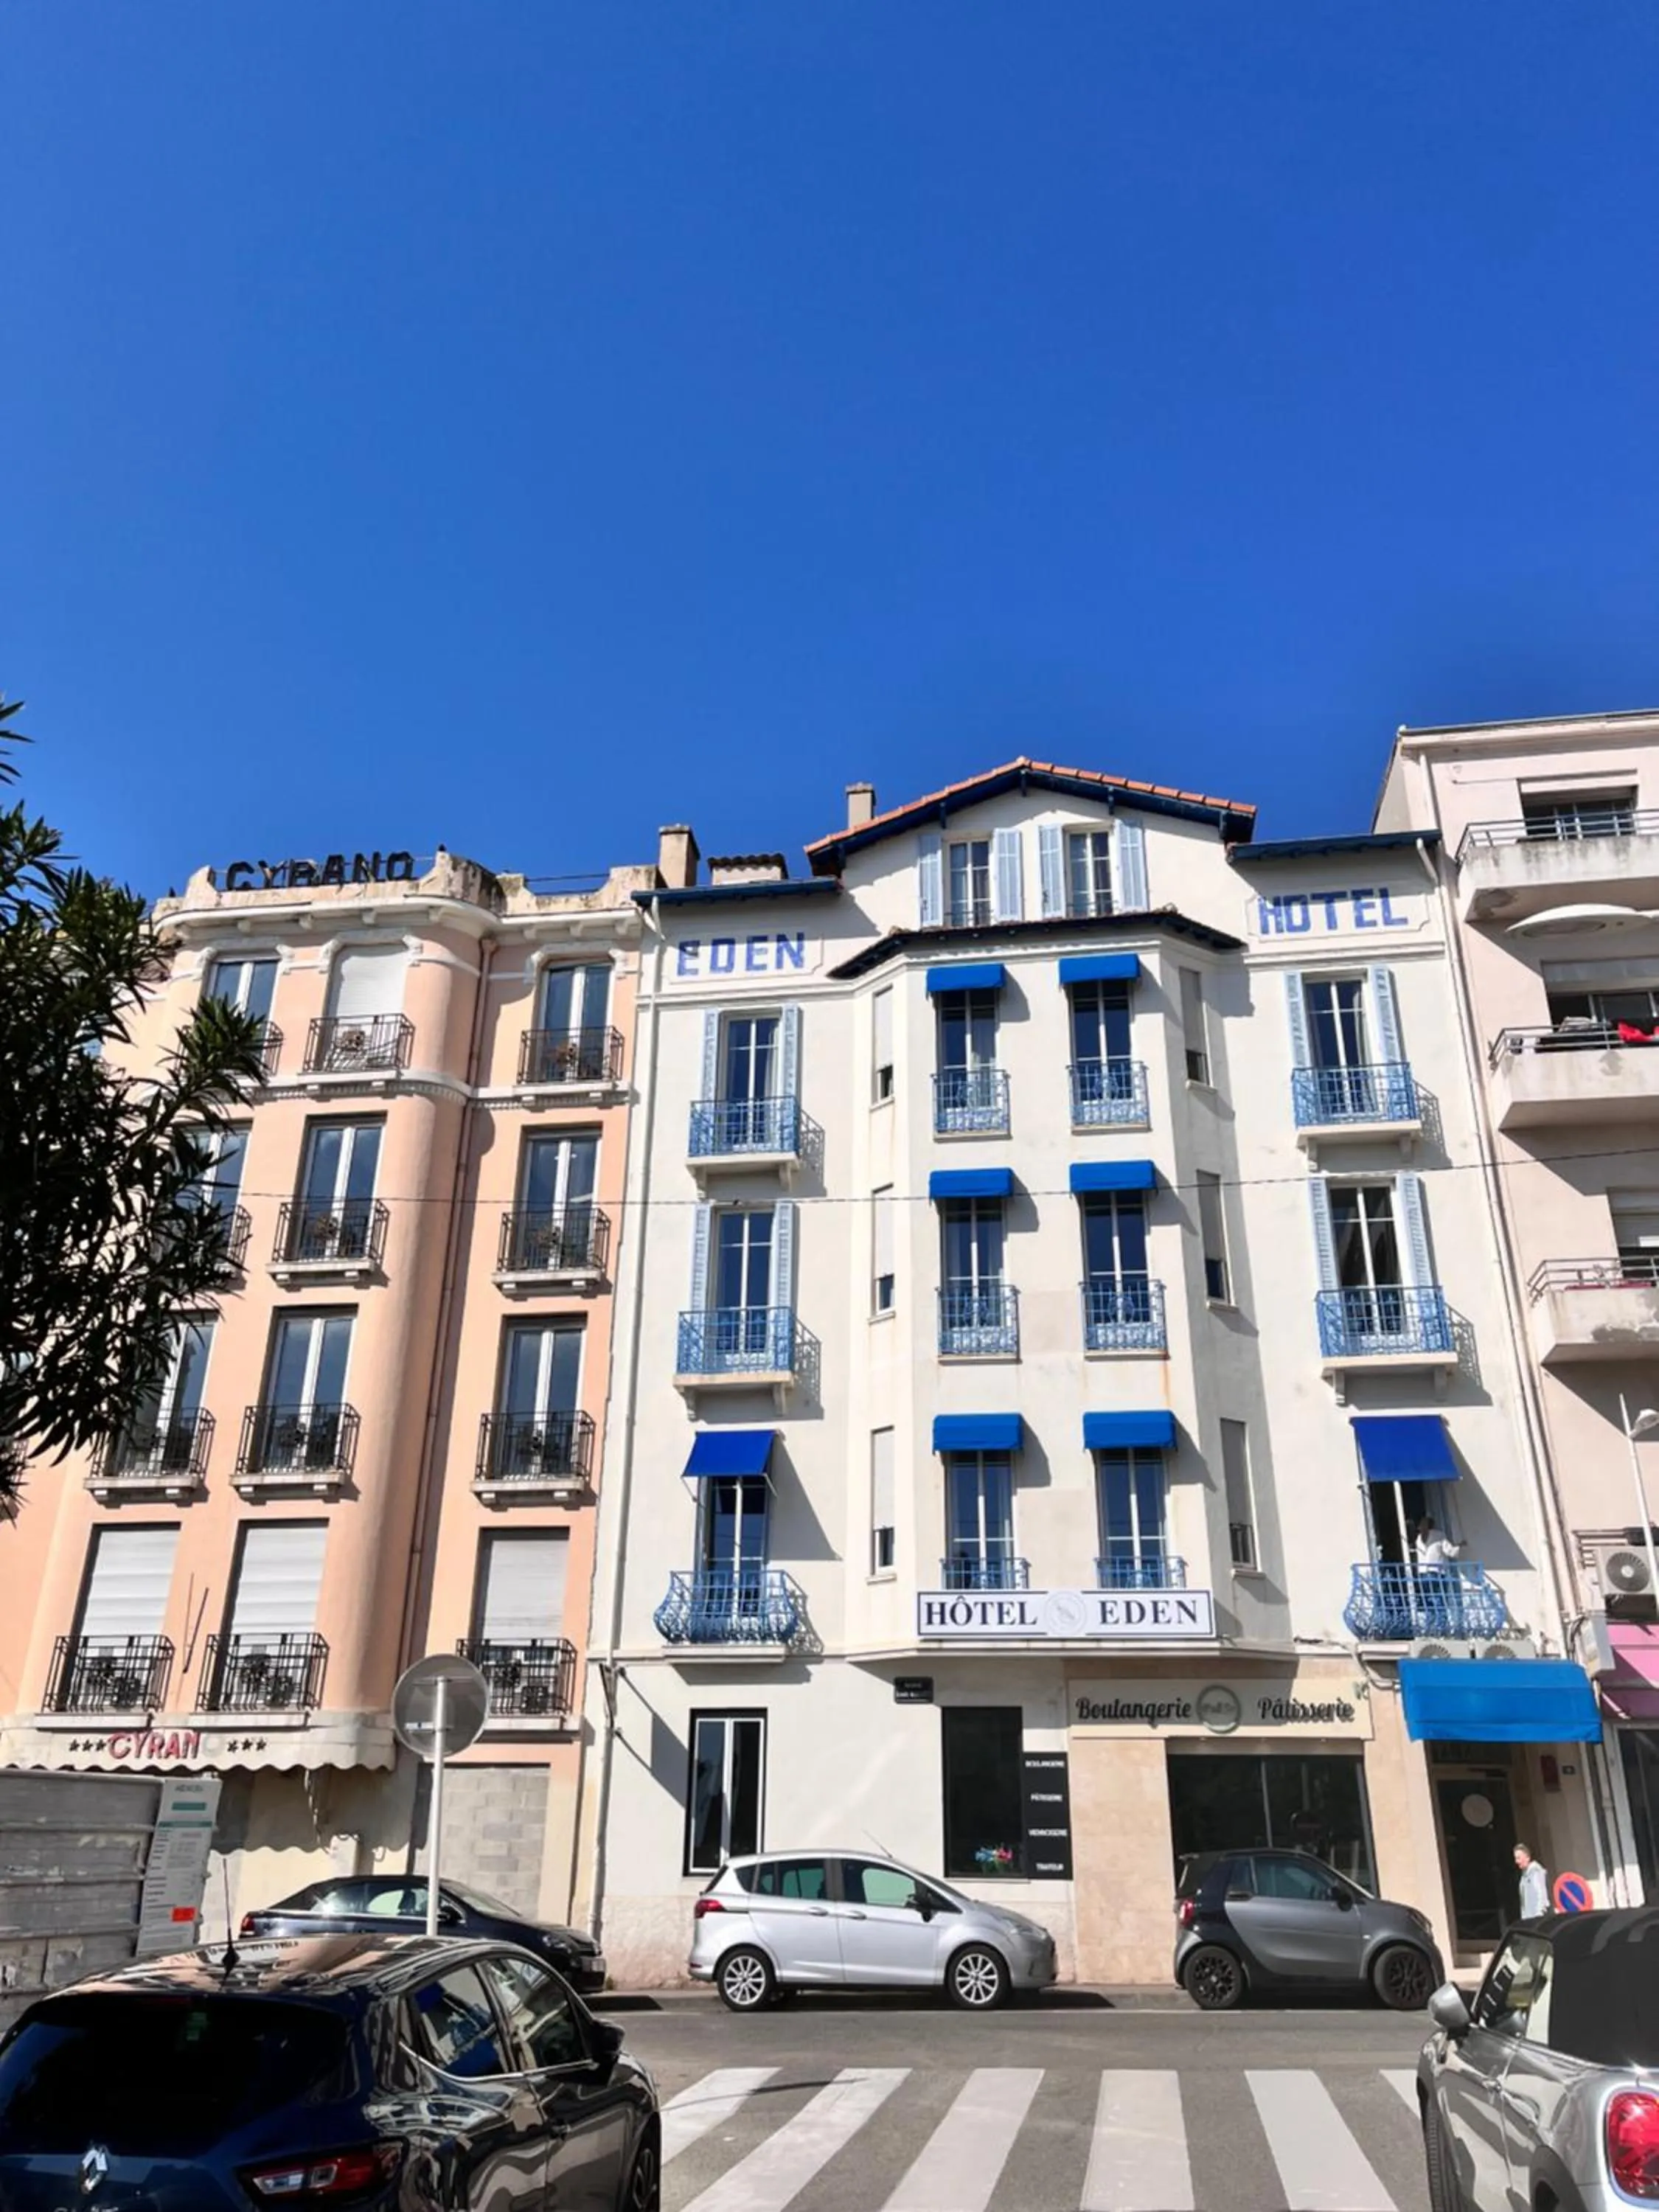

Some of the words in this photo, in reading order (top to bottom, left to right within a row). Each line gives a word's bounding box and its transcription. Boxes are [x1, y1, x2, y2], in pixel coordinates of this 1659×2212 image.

[1258, 888, 1408, 934] HOTEL
[677, 932, 805, 976] EDEN
[925, 1595, 1037, 1626] HÔTEL
[1099, 1599, 1197, 1624] EDEN
[1075, 1698, 1192, 1728] Boulangerie
[1256, 1697, 1355, 1723] Pâtisserie
